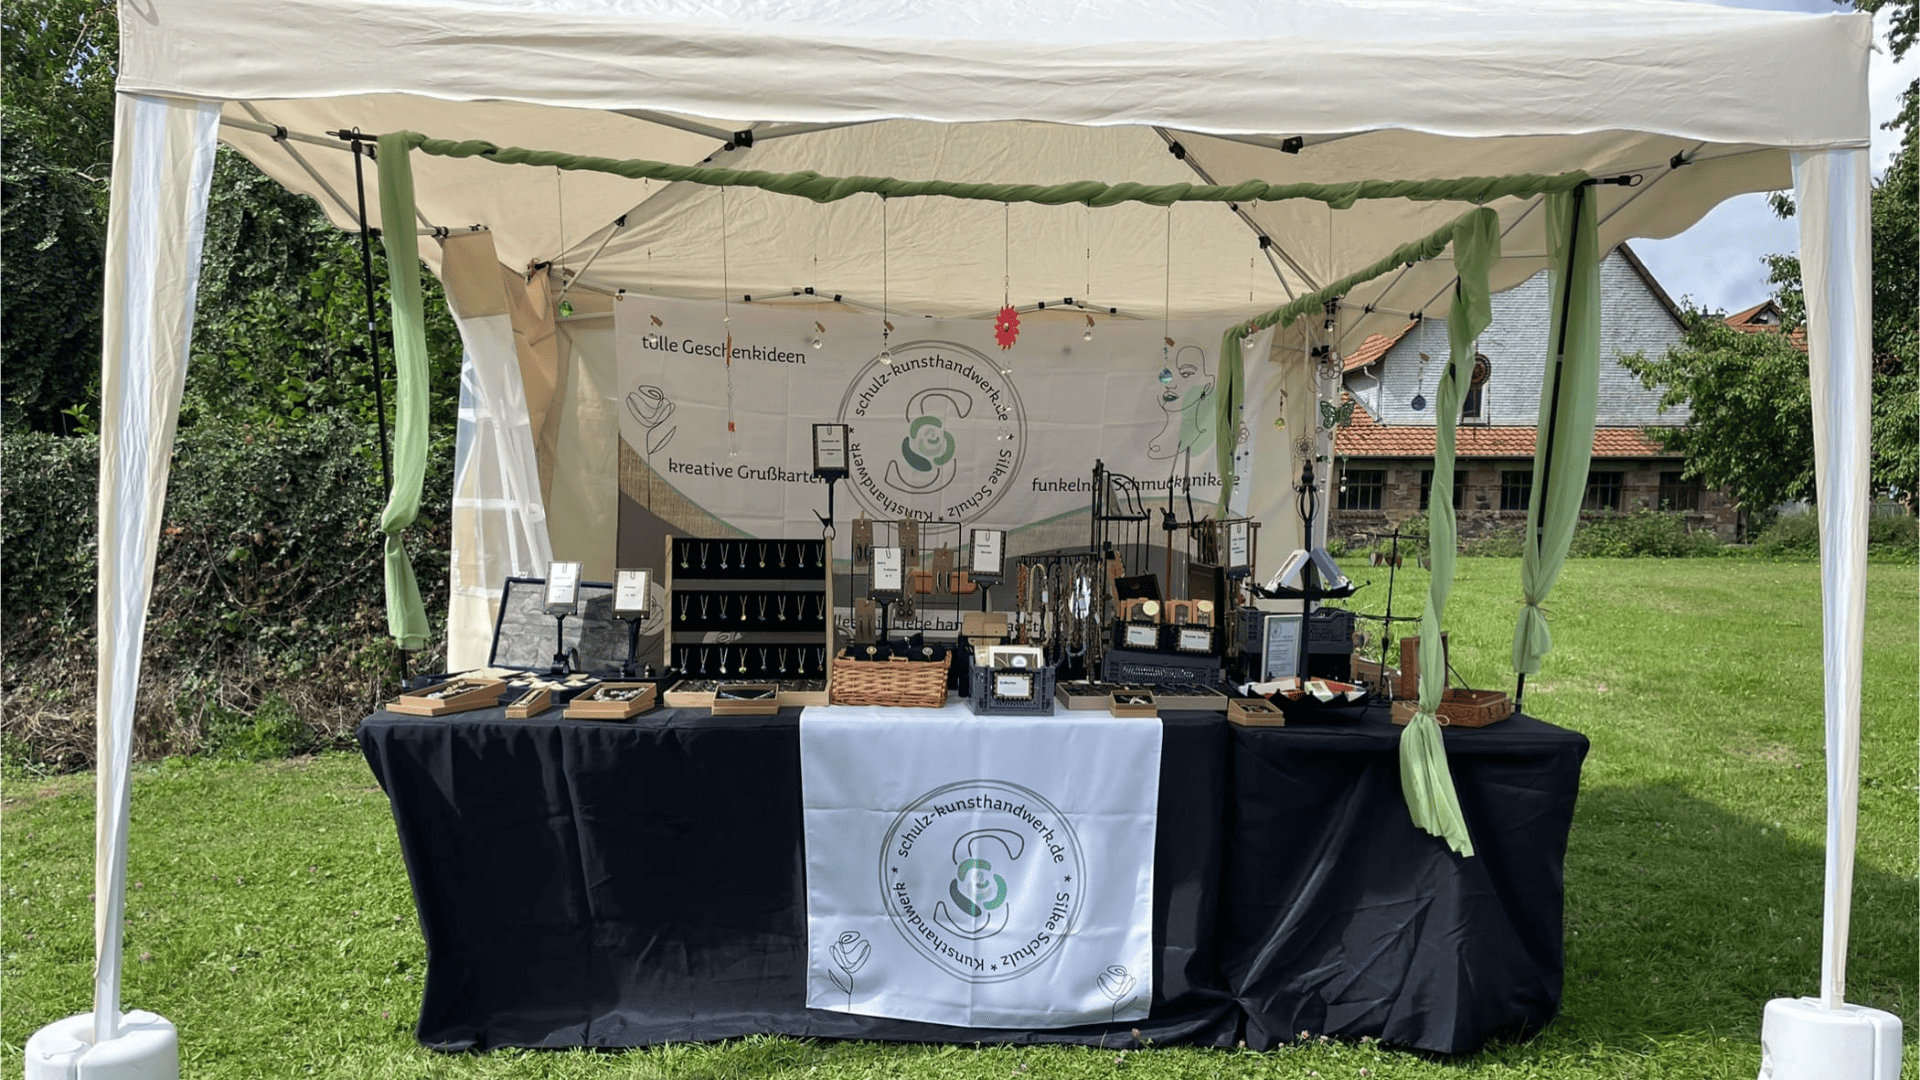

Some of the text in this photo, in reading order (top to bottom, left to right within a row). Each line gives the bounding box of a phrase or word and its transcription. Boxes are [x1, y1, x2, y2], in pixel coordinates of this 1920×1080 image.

[642, 335, 678, 352] tolle
[855, 354, 1008, 421] schulz-kunsthandwerk.de
[668, 457, 733, 477] kreative
[850, 443, 932, 521] Kunsthandwerk
[988, 449, 1011, 484] Silke
[947, 485, 992, 517] Schulz
[898, 794, 1064, 863] schulz-kunsthandwerk.de
[892, 882, 1070, 971] Silke Schulz Kunsthandwerk
